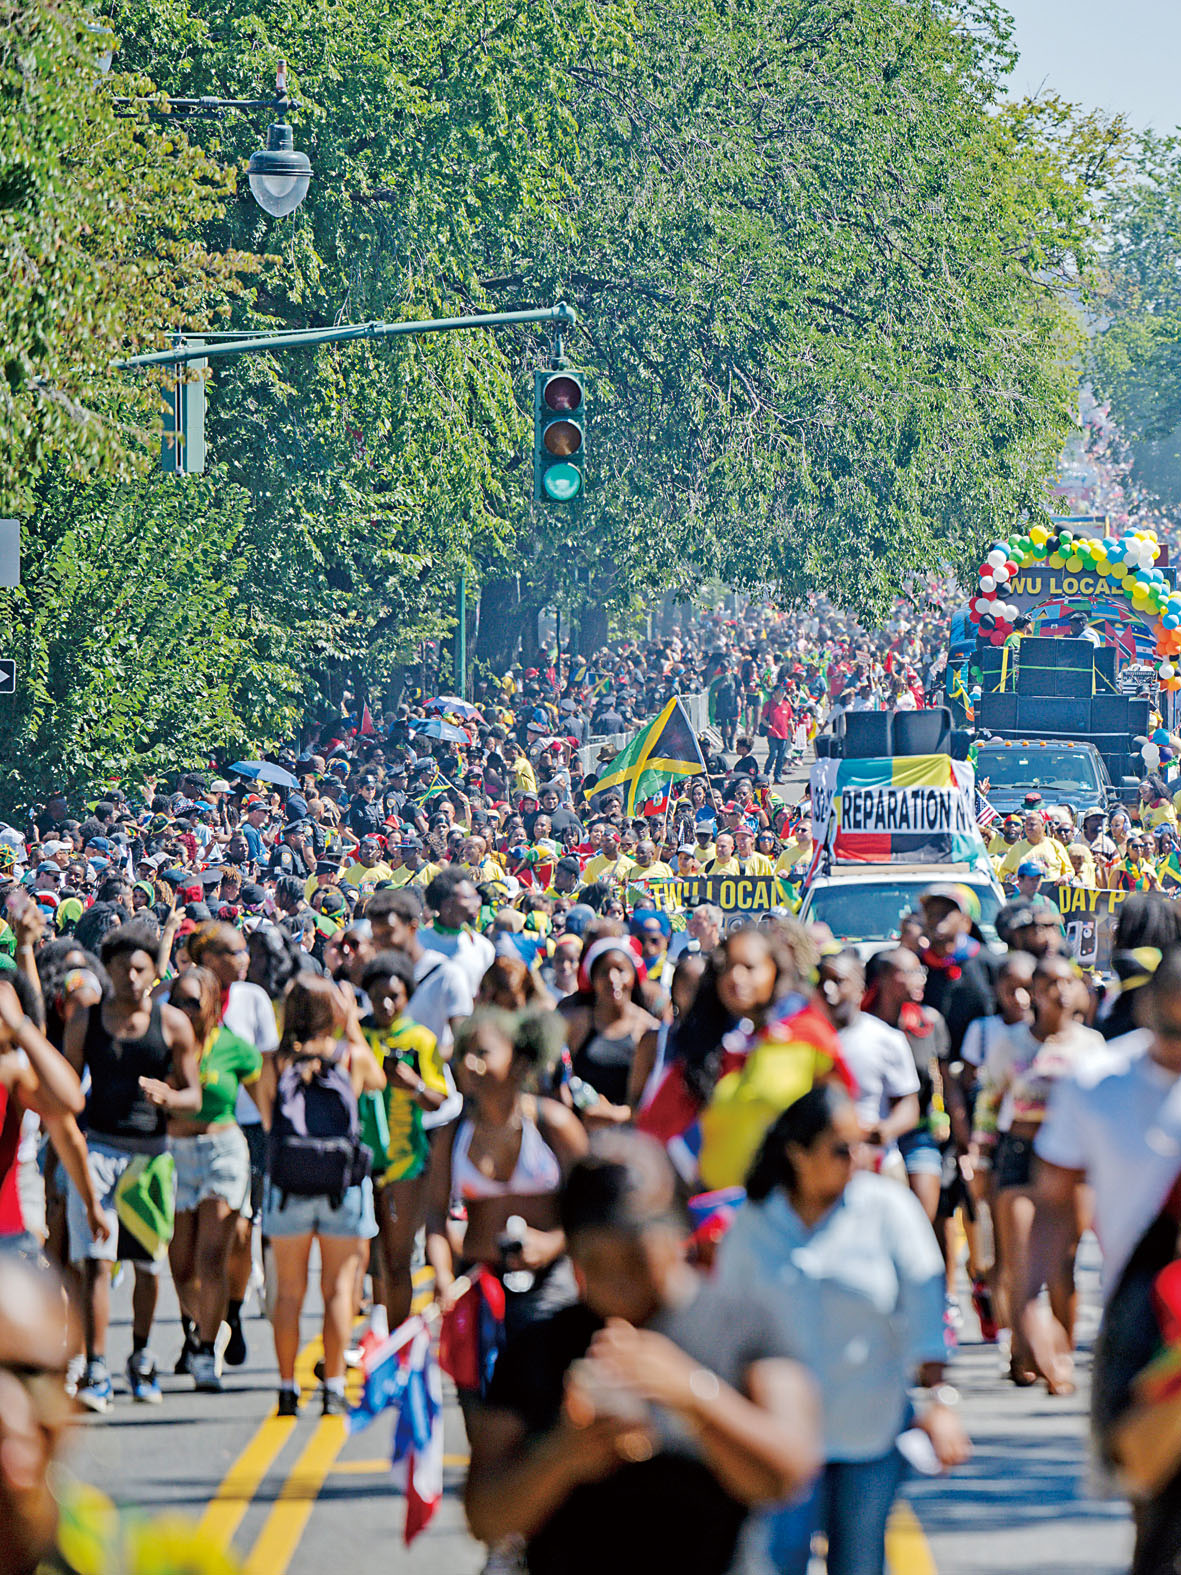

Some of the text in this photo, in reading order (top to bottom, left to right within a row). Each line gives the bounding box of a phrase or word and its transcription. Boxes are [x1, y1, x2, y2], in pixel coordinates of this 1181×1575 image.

[1010, 577, 1124, 595] WU LOCAL
[842, 789, 950, 830] REPARATION
[1058, 885, 1101, 914] DAY
